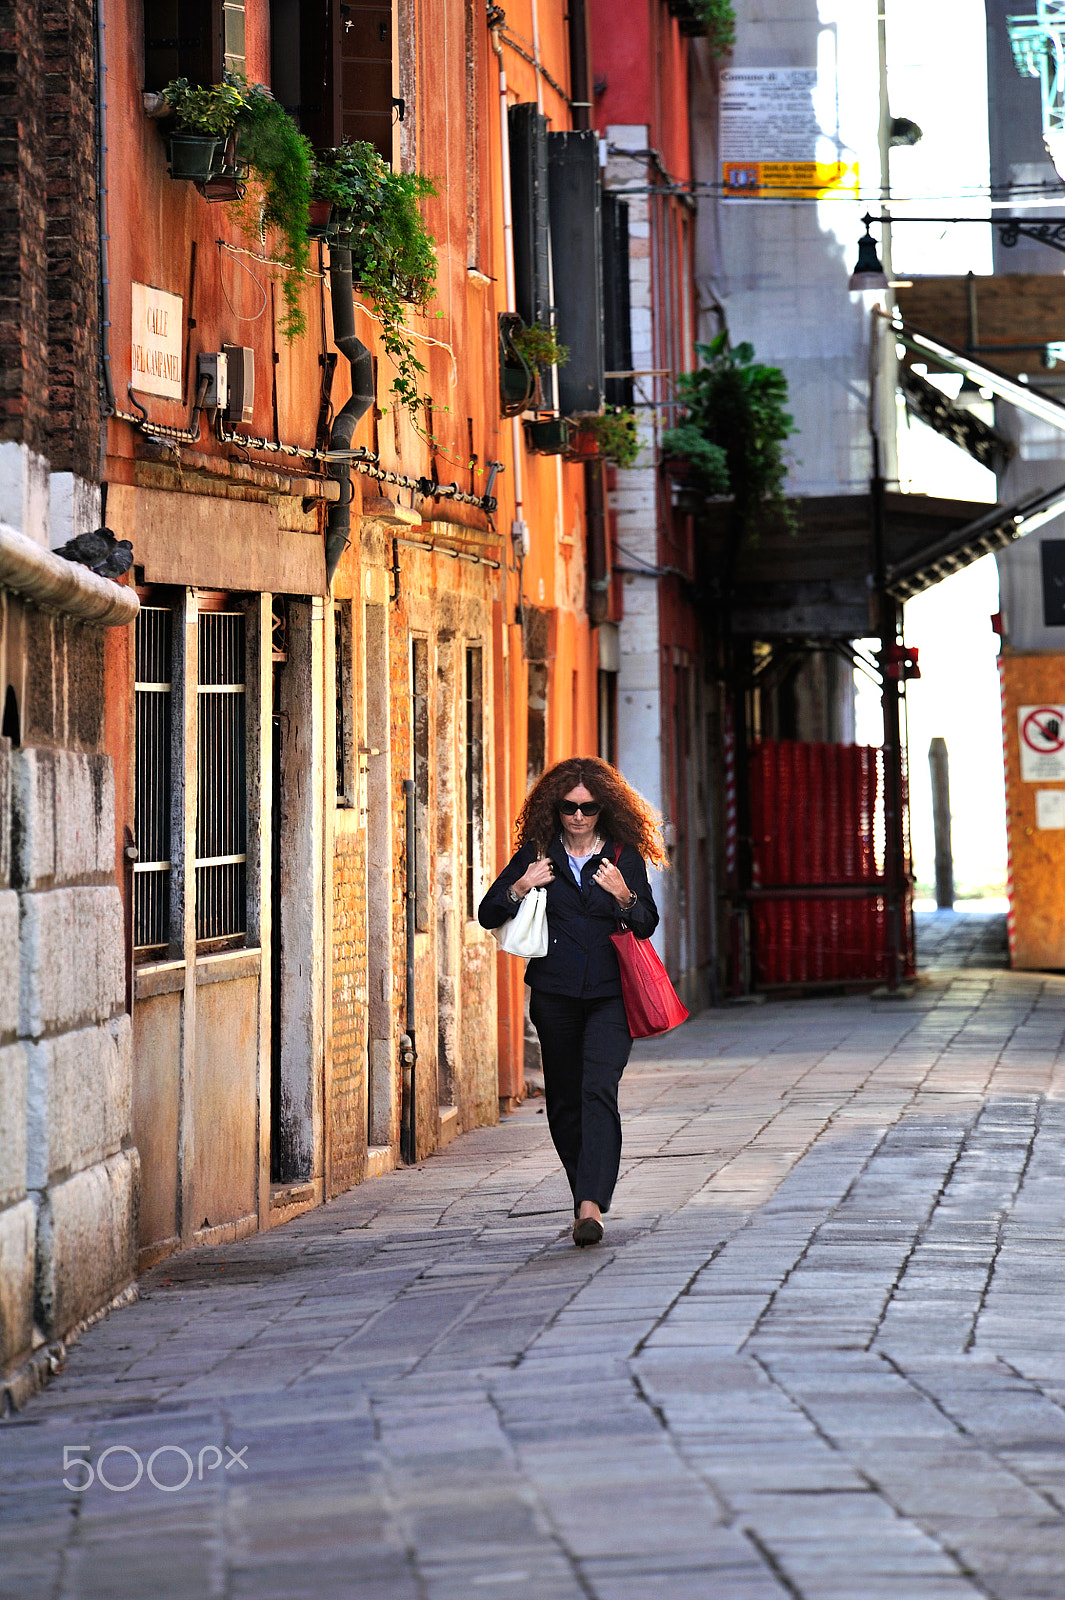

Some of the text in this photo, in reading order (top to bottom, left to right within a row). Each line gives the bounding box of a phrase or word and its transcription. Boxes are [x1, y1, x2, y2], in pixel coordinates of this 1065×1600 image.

[146, 306, 168, 338] CALLE
[132, 343, 181, 383] DEL CAMPANIEL
